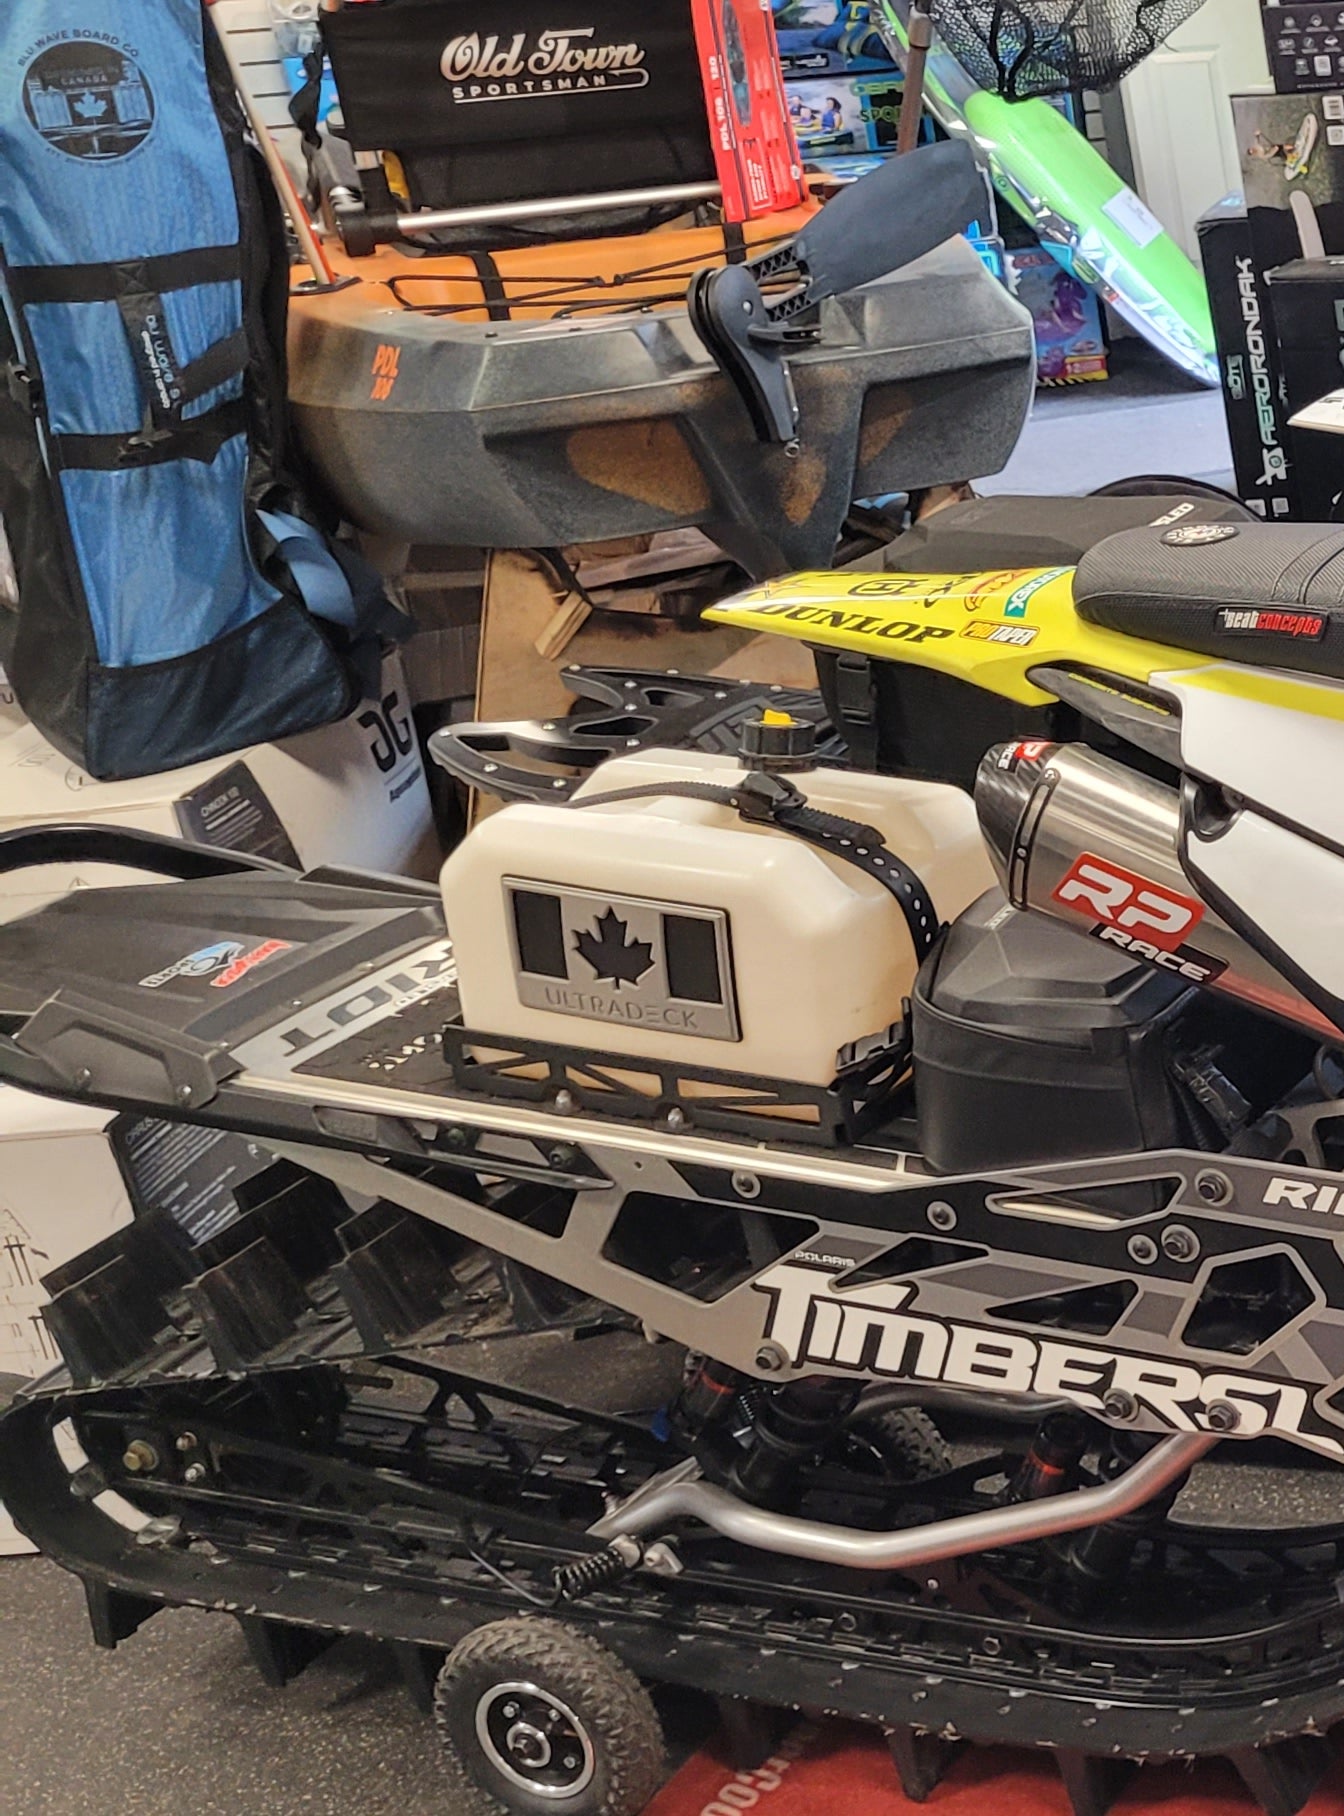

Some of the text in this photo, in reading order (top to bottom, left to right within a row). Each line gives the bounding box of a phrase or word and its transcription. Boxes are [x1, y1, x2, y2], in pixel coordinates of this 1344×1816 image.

[34, 30, 70, 49] WAVE
[72, 29, 120, 46] BOARD
[440, 27, 648, 83] Old Town
[452, 74, 607, 100] SPORTSMAN
[371, 344, 400, 378] PDL
[1234, 257, 1277, 446] AERORONDAK
[746, 603, 957, 645] DUNLOP
[1057, 862, 1196, 940] RP
[1097, 922, 1215, 981] RACE
[544, 986, 701, 1030] ULTRADECK
[793, 1248, 857, 1269] POLARIS
